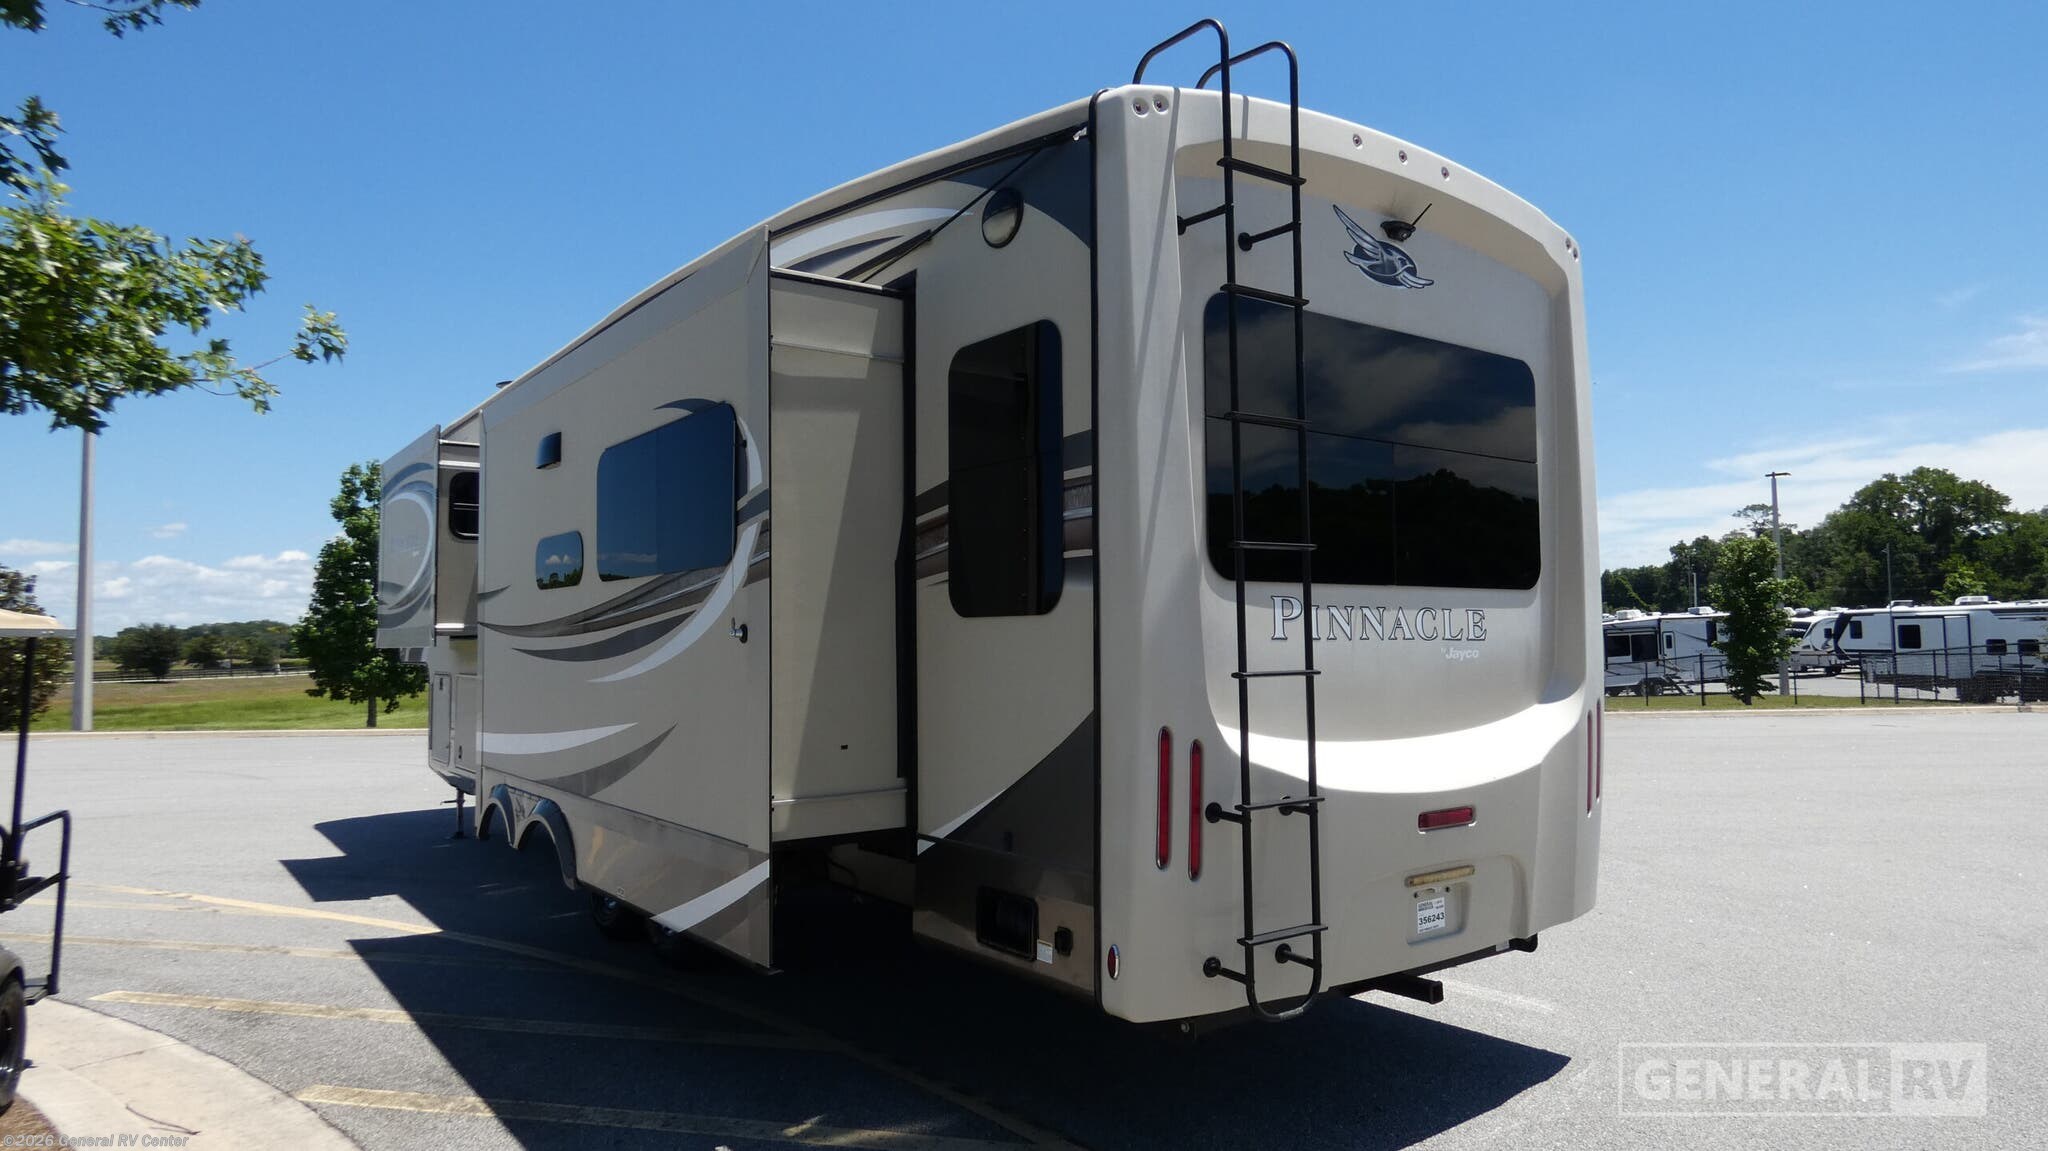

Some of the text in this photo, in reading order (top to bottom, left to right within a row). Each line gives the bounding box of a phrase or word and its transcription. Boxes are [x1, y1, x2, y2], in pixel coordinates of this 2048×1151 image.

[1271, 595, 1487, 641] PINNACLE
[1445, 647, 1480, 661] Jayco
[1418, 911, 1445, 926] 356243
